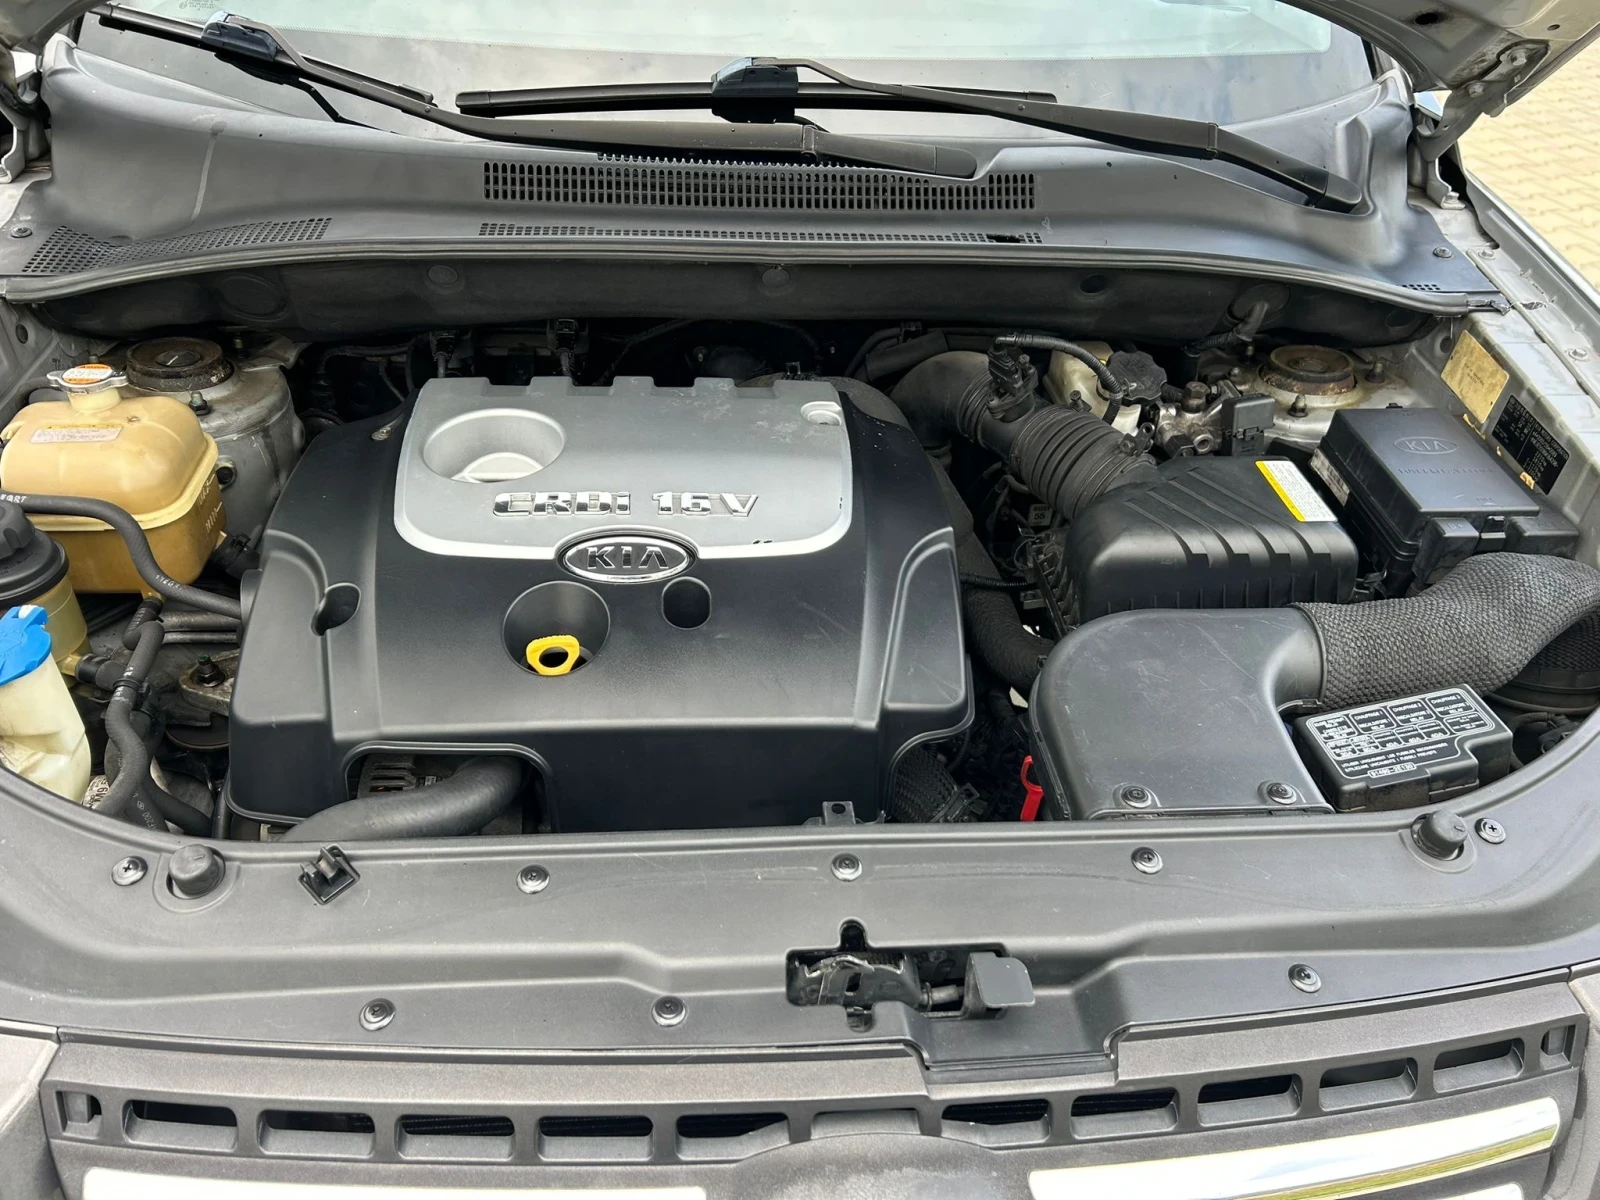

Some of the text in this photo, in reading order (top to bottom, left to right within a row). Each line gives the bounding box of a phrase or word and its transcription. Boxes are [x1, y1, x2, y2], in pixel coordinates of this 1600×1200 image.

[1405, 440, 1449, 451] KIA
[492, 491, 631, 516] CRDi
[586, 546, 669, 569] KIA
